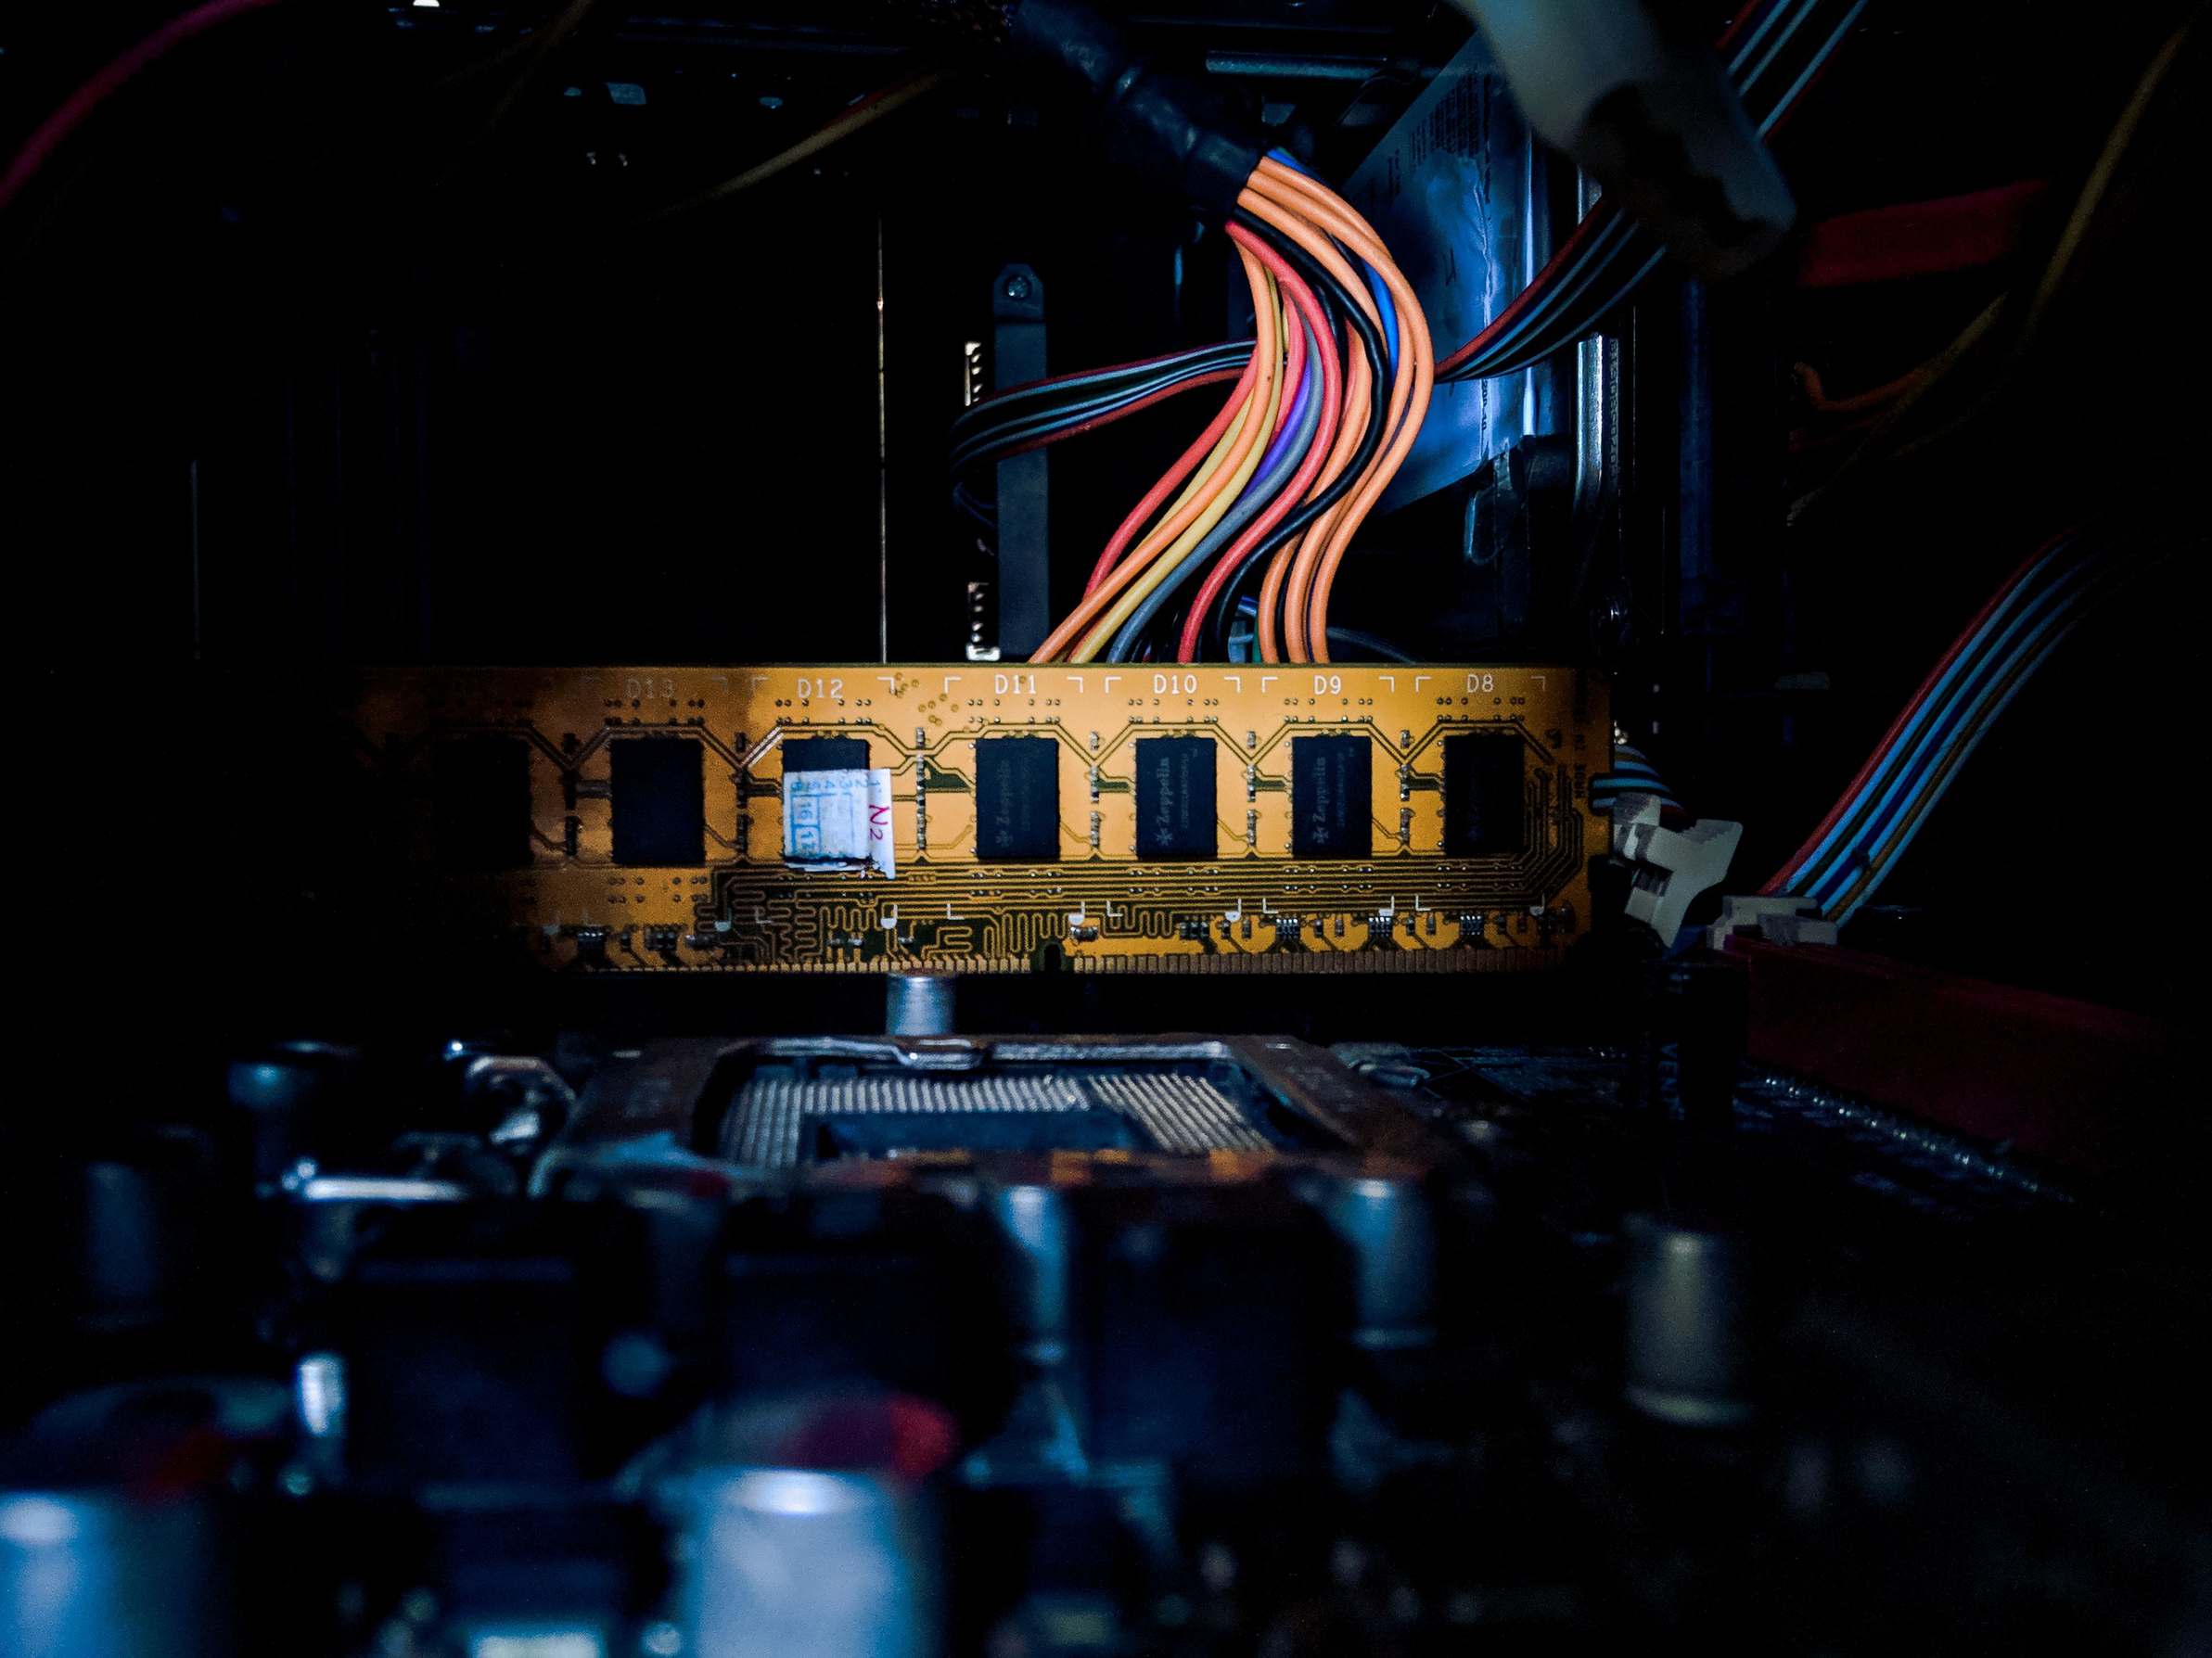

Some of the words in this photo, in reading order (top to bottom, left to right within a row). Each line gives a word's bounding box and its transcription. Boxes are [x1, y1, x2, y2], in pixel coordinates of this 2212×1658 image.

[797, 678, 844, 698] D12
[994, 674, 1036, 694] D11
[1154, 674, 1197, 694] D10
[1313, 675, 1341, 695] D9
[1466, 673, 1494, 693] D8
[1156, 757, 1173, 825] Zeppelin
[1312, 757, 1330, 823] Zeppelin
